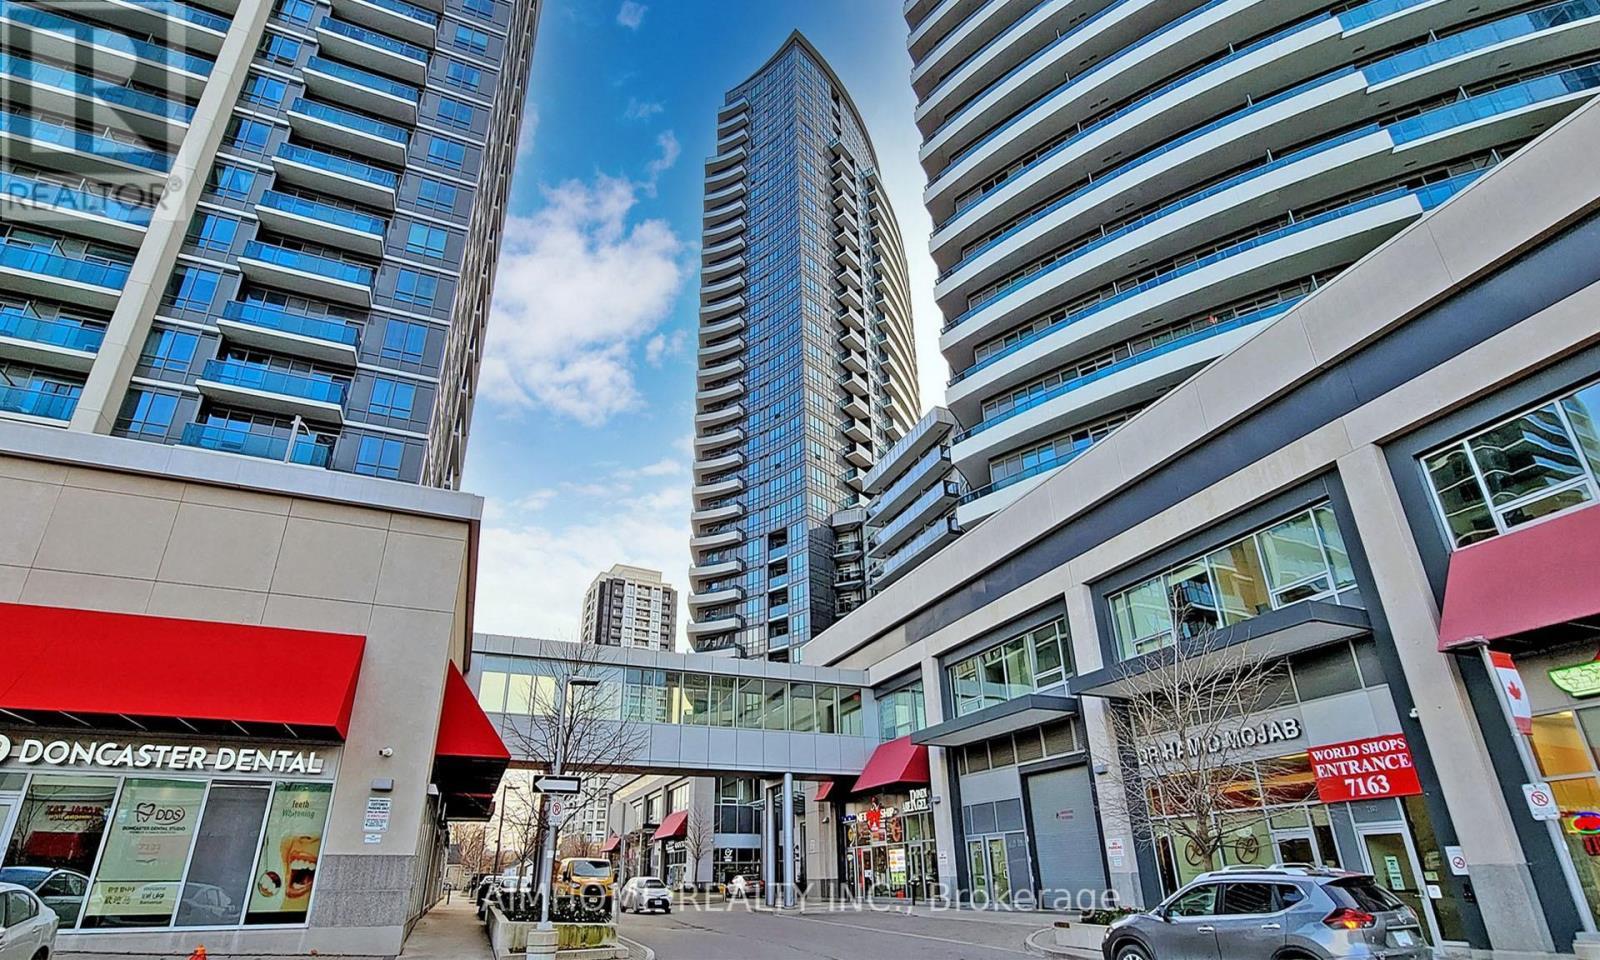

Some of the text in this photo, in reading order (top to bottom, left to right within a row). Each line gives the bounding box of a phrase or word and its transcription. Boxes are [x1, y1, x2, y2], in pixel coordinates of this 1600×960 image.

[1224, 718, 1300, 748] MOJAB
[18, 739, 322, 773] DONCASTER DENTAL
[1312, 738, 1406, 761] WORLD SHOPS
[1315, 753, 1412, 778] ENTRANCE
[1344, 775, 1391, 797] 7163
[155, 808, 182, 821] DDS
